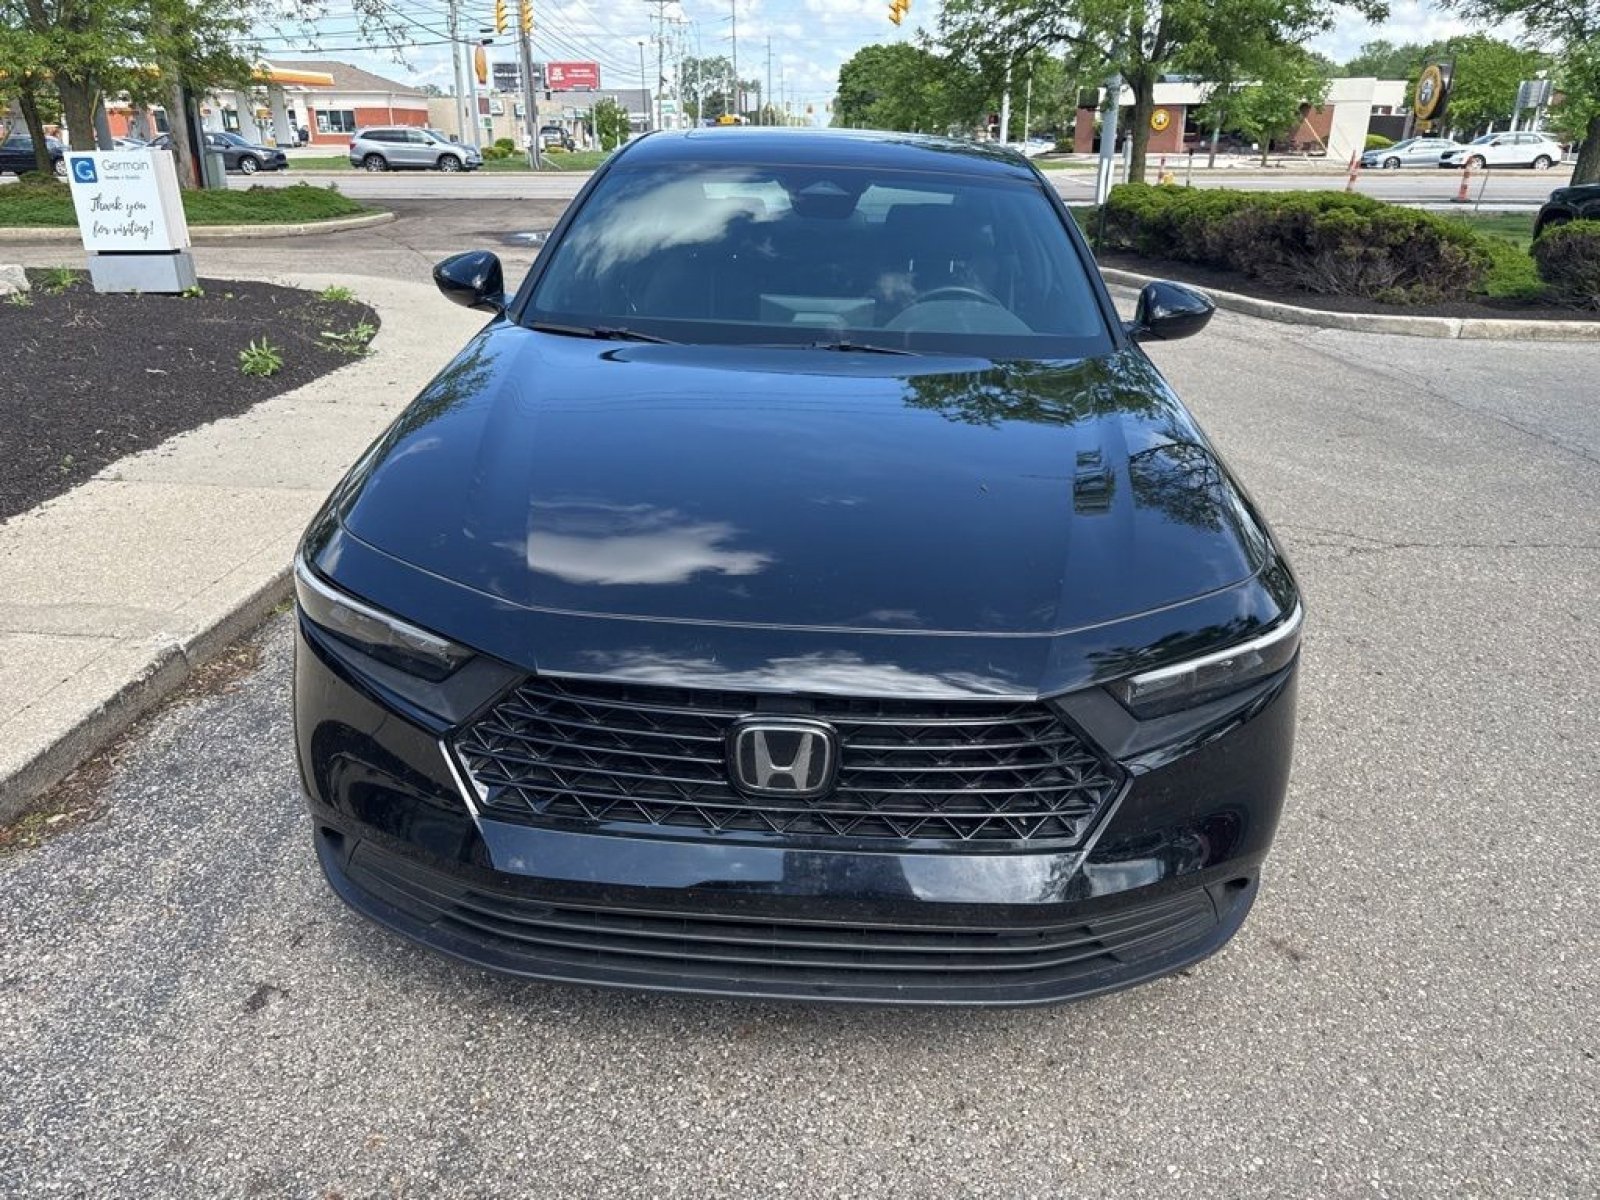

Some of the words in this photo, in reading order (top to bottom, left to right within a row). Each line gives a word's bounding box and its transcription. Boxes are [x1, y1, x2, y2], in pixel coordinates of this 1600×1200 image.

[101, 158, 149, 171] Germain
[90, 192, 123, 212] Thank
[126, 200, 147, 218] you
[92, 220, 110, 238] for
[113, 219, 154, 240] visiting!
